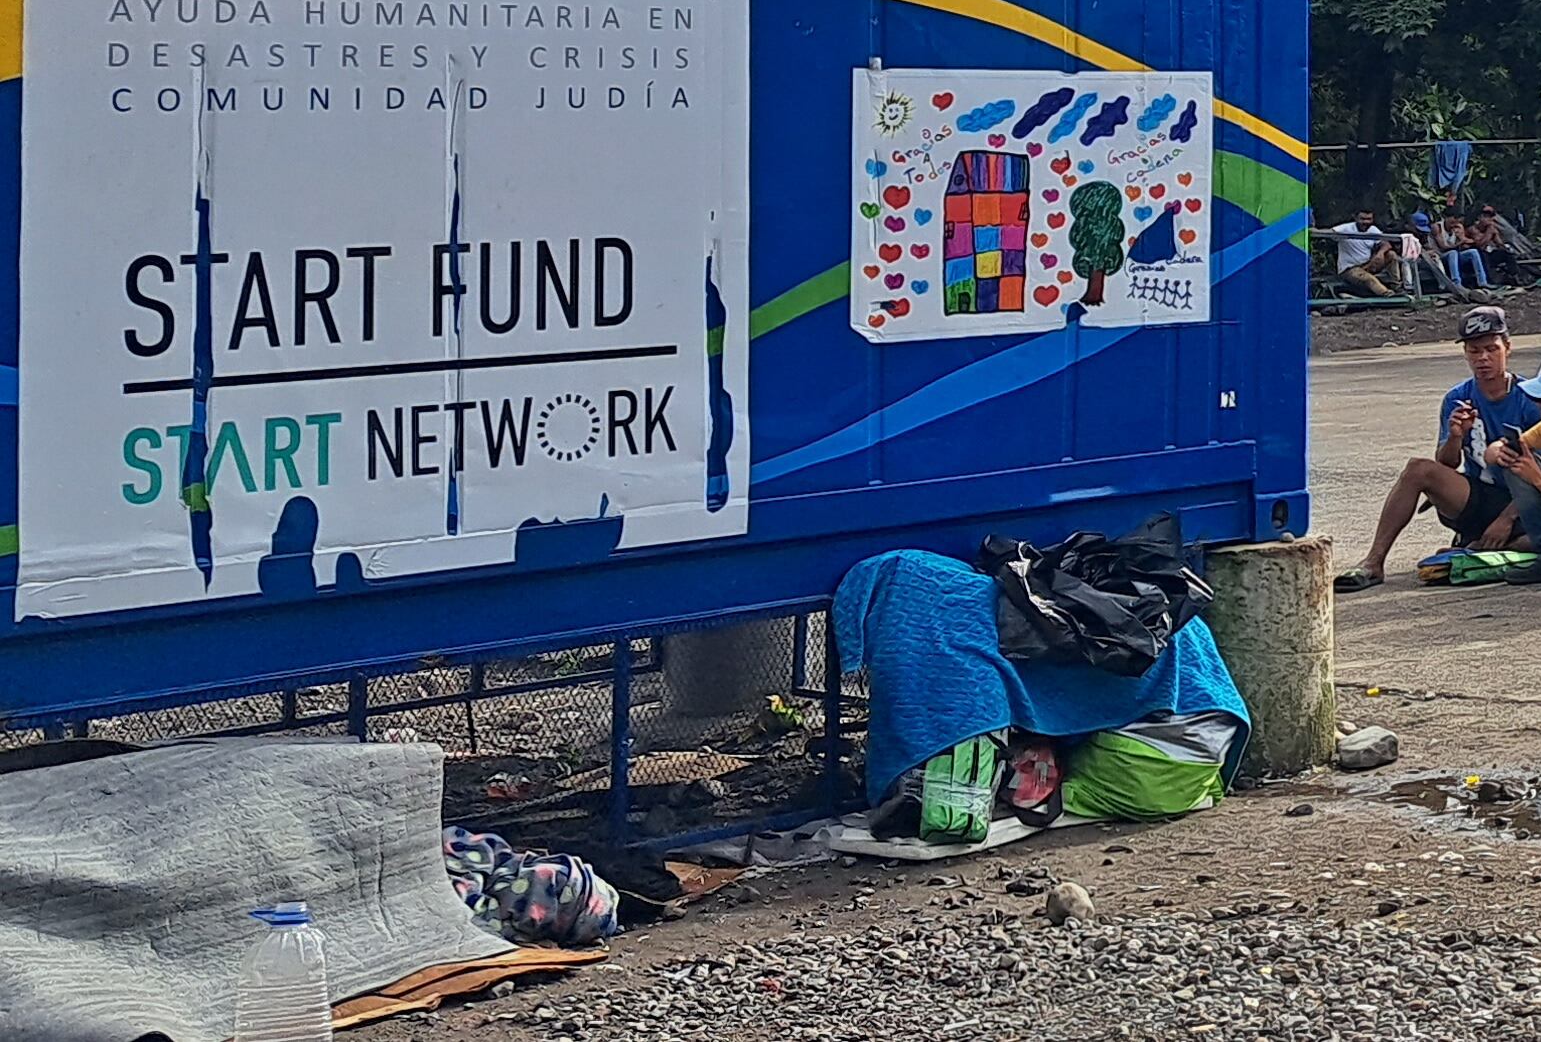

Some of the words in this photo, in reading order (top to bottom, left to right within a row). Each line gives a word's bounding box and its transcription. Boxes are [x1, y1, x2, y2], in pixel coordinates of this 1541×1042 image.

[305, 1, 621, 30] HUMANITARIA
[649, 8, 693, 30] EN
[108, 43, 428, 69] DESASTRES
[471, 46, 488, 68] Y
[529, 47, 689, 69] CRISIS
[112, 87, 487, 112] COMUNIDAD
[535, 81, 690, 110] JUDÍA
[891, 125, 953, 164] Gracias
[1107, 132, 1167, 165] Gracias
[903, 160, 952, 184] Todos
[124, 247, 392, 358] SART
[432, 237, 634, 337] FUND
[366, 385, 678, 481] NETWORK
